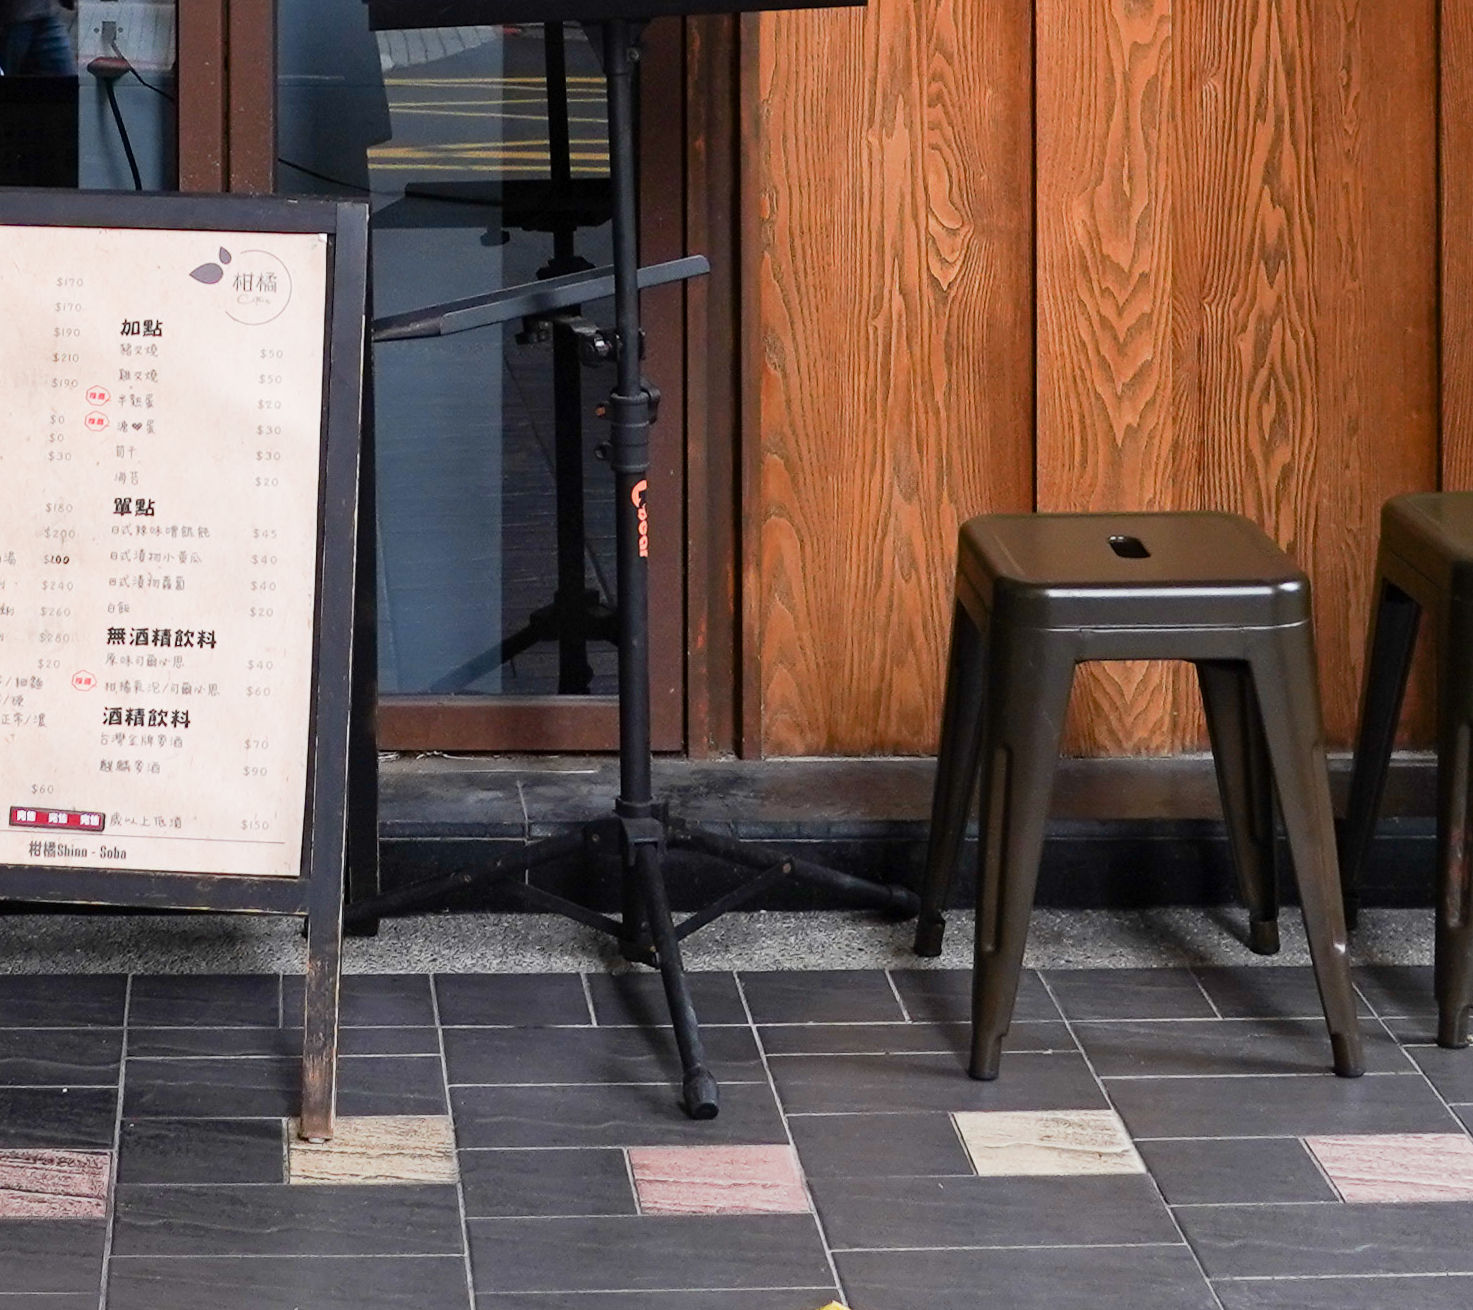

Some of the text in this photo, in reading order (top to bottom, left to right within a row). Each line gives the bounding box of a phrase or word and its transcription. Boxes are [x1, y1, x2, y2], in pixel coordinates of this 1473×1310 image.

[233, 272, 277, 293] 柑橘
[121, 319, 163, 337] 加點
[113, 498, 155, 516] 單點
[106, 627, 217, 648] 無酒精飲料
[103, 706, 191, 728] 酒精飲料
[100, 846, 127, 859] Soba
